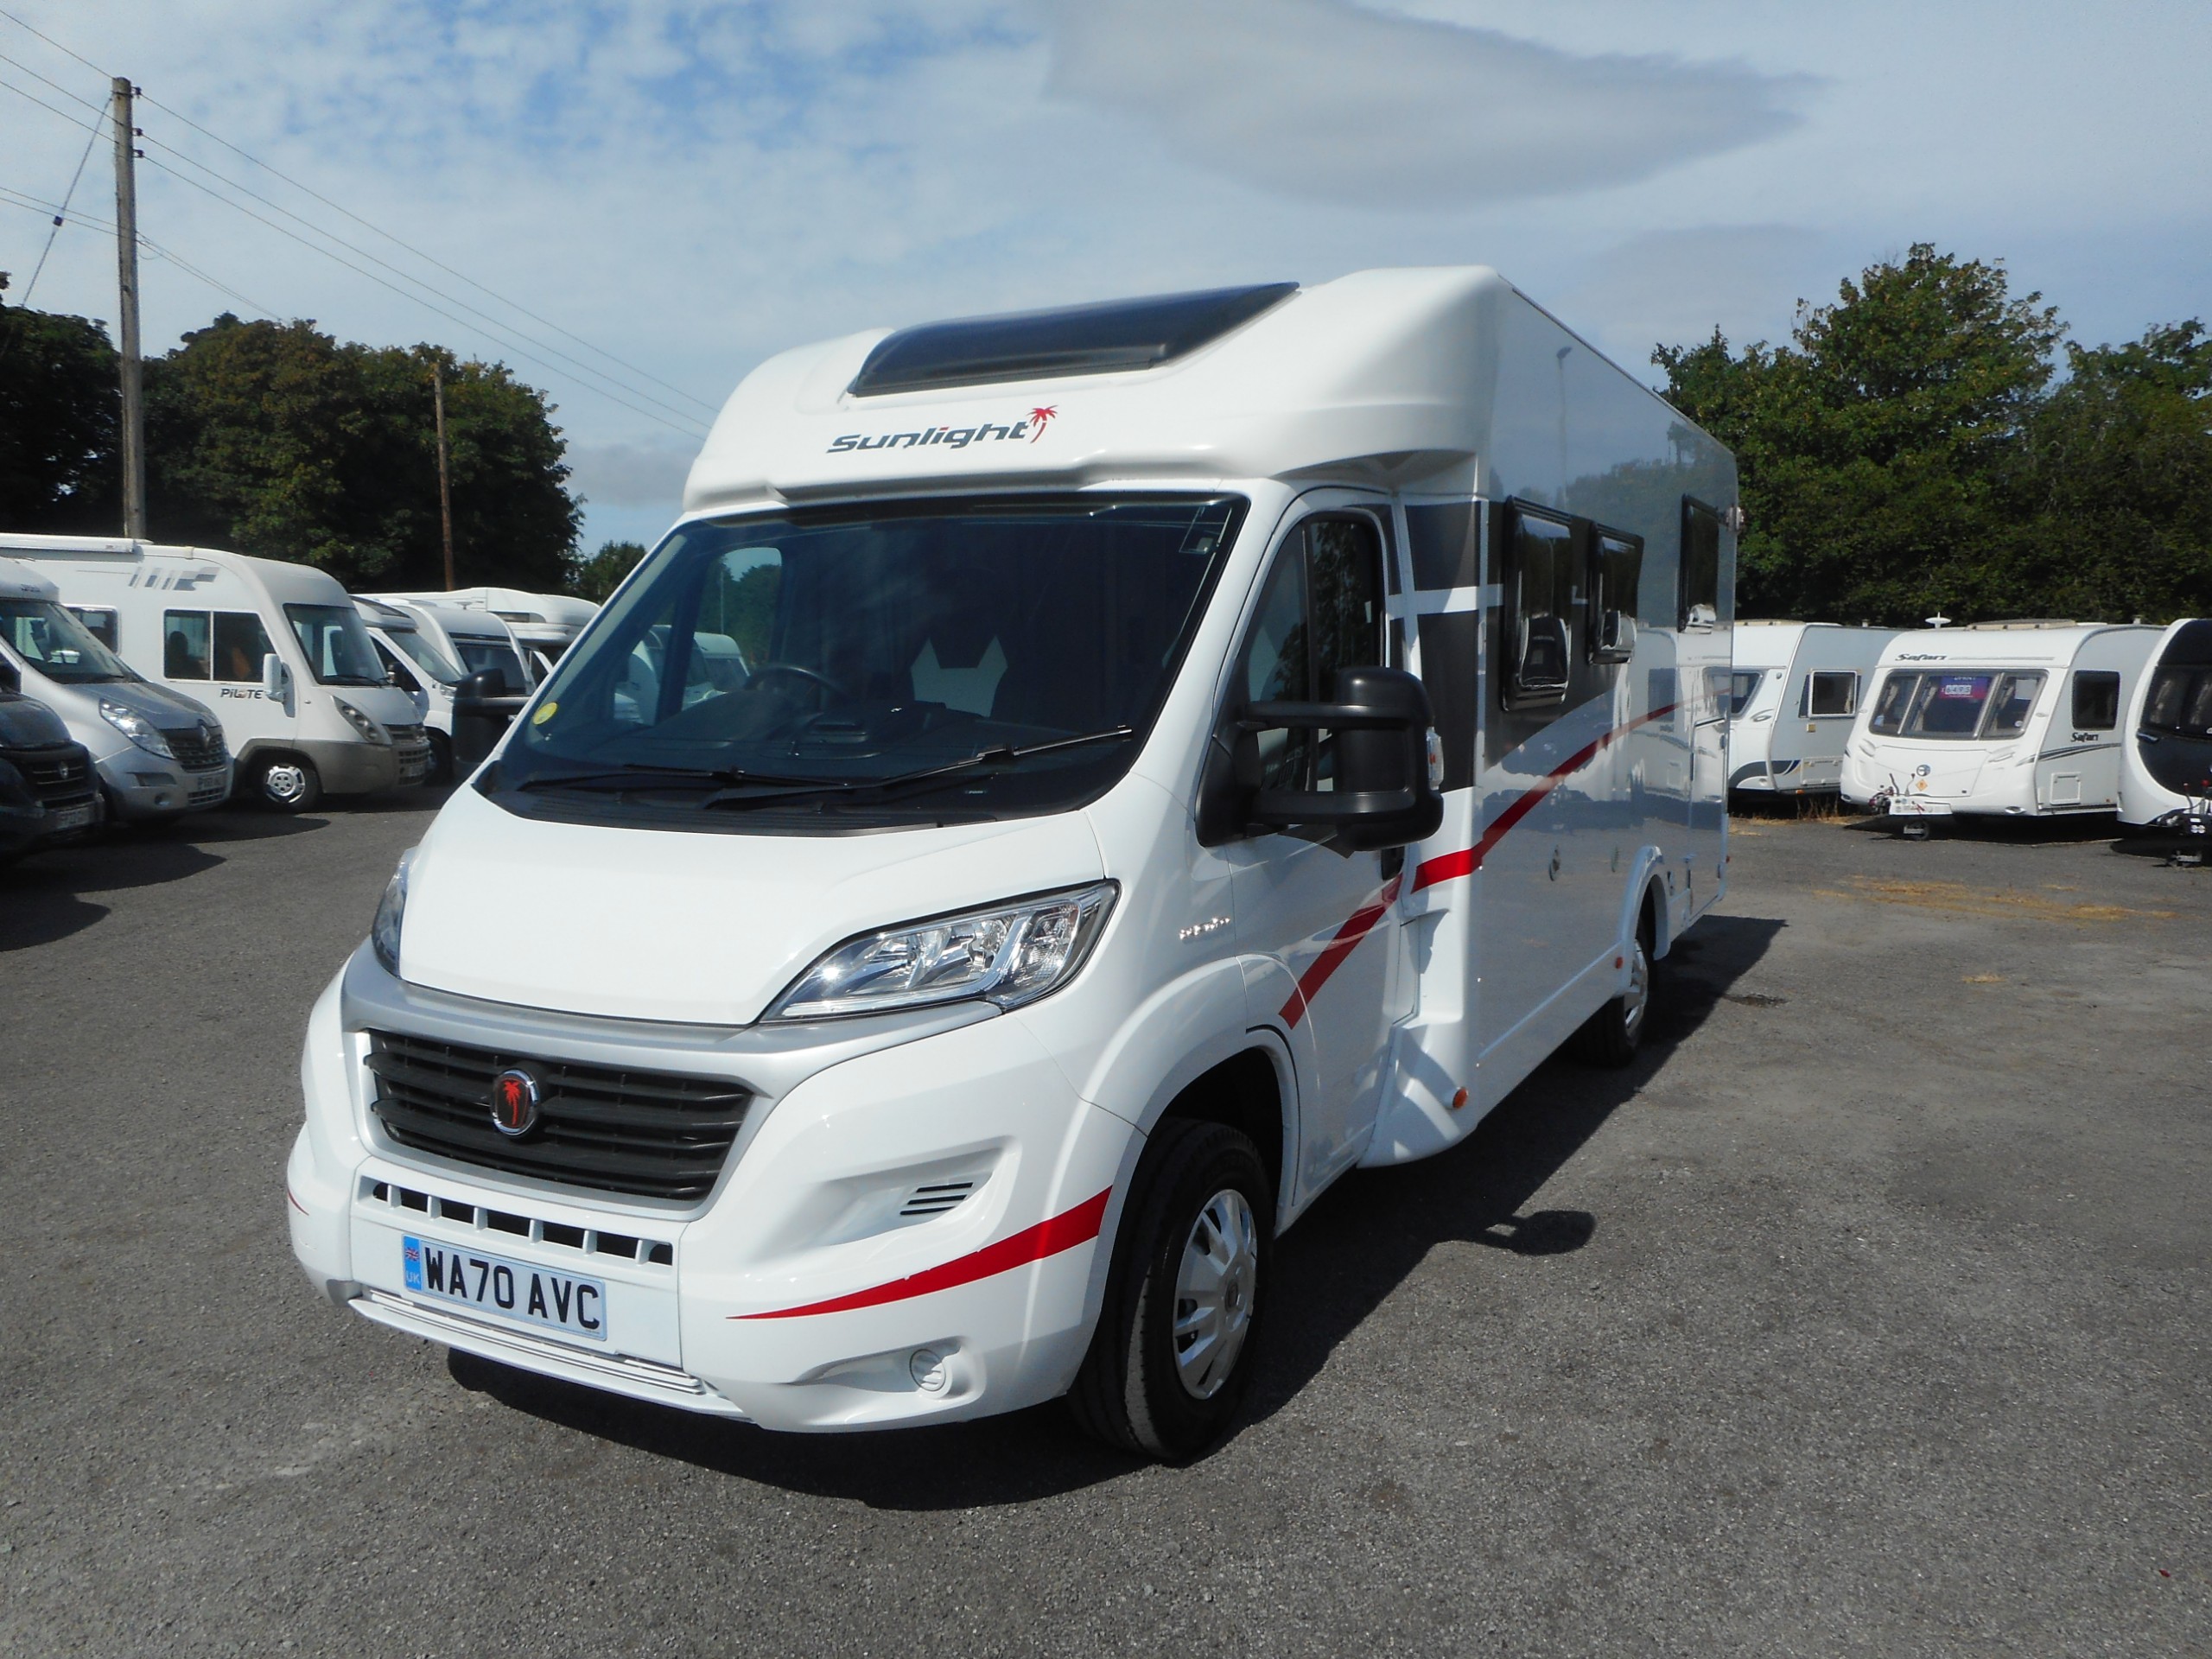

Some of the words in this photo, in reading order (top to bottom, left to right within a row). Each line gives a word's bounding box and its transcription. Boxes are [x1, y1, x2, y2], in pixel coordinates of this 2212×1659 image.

[825, 420, 1030, 454] Sunlight
[1895, 653, 1948, 662] Safari
[2070, 732, 2099, 743] Safari
[406, 1272, 421, 1285] UK
[424, 1246, 515, 1310] WA70
[527, 1272, 601, 1331] AVC
